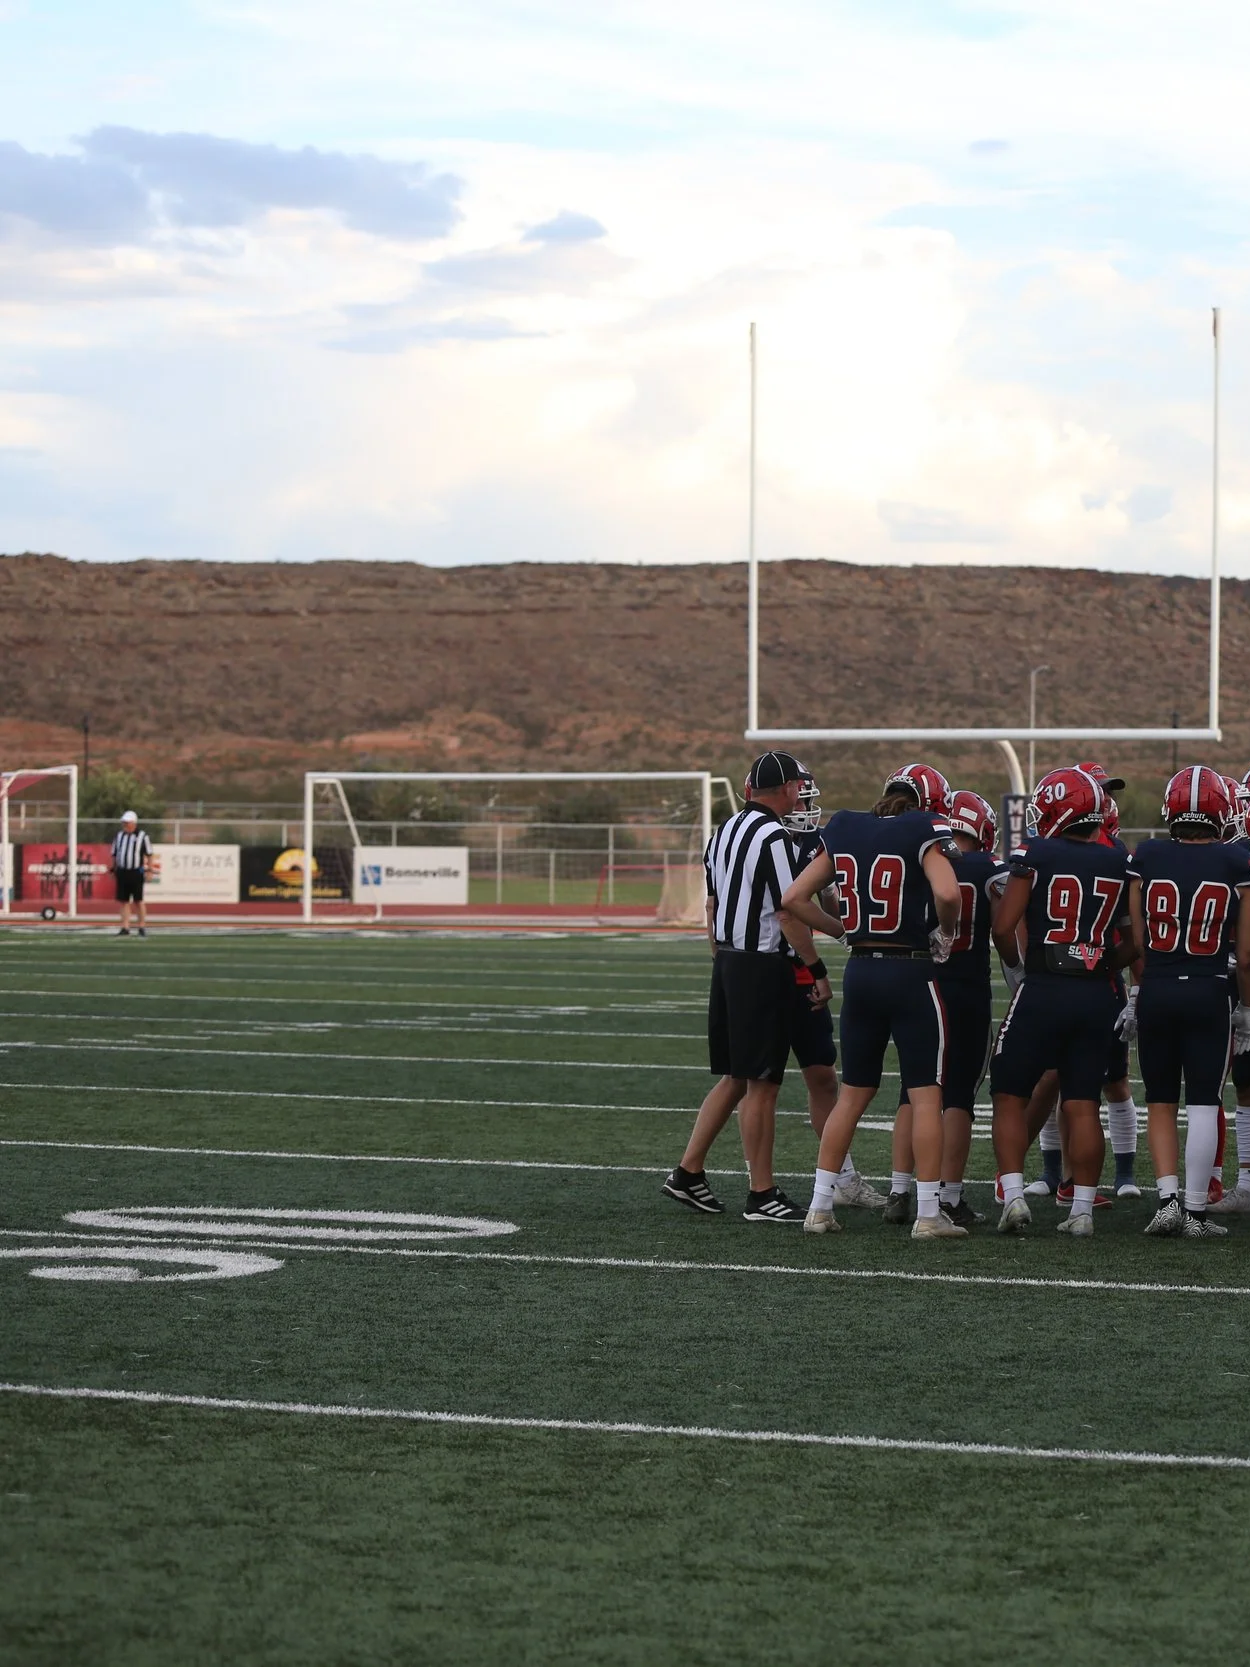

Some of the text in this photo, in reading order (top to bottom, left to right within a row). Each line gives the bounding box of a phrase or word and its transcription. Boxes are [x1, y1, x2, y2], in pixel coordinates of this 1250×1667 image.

[1044, 782, 1067, 804] 30
[385, 867, 460, 878] Bonneville
[834, 853, 905, 934] 39
[1043, 874, 1125, 947] 97
[1146, 879, 1232, 956] 80
